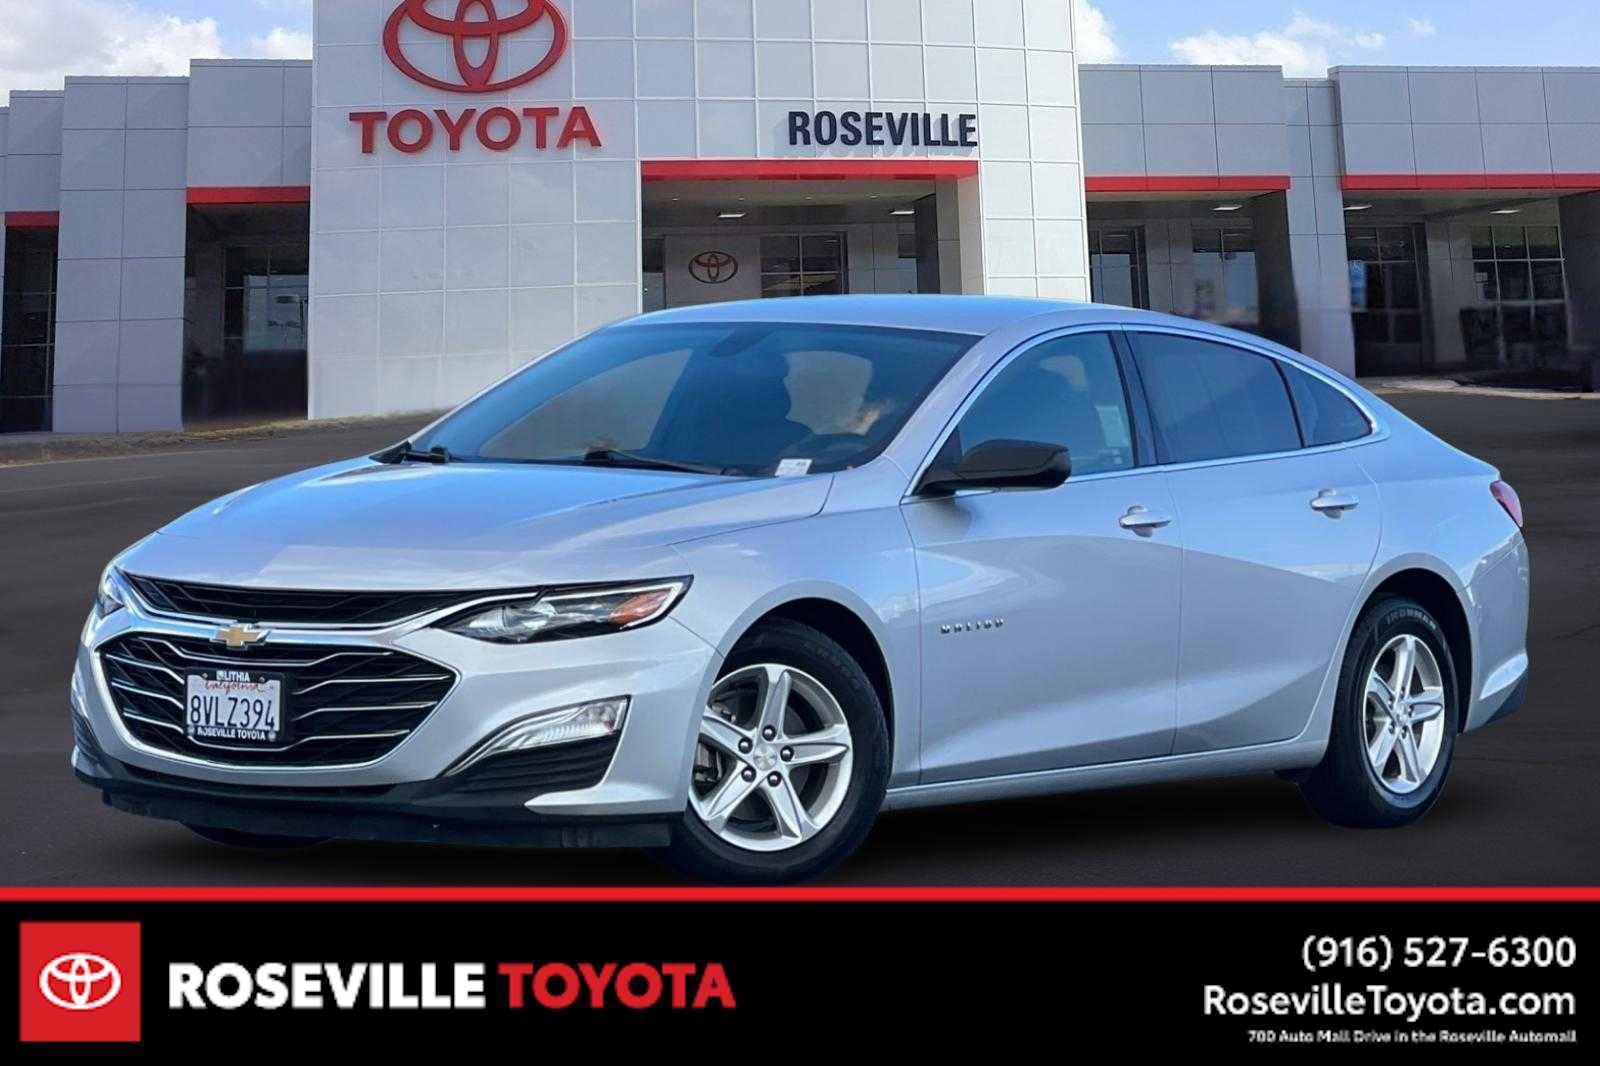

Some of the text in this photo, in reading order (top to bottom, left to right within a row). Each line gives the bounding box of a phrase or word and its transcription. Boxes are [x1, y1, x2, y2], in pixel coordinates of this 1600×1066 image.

[349, 106, 602, 154] TOYOTA
[788, 110, 978, 147] ROSEVILLE
[190, 694, 276, 730] 8VLZ394
[197, 726, 266, 741] ROSEVILLE TOYOTA
